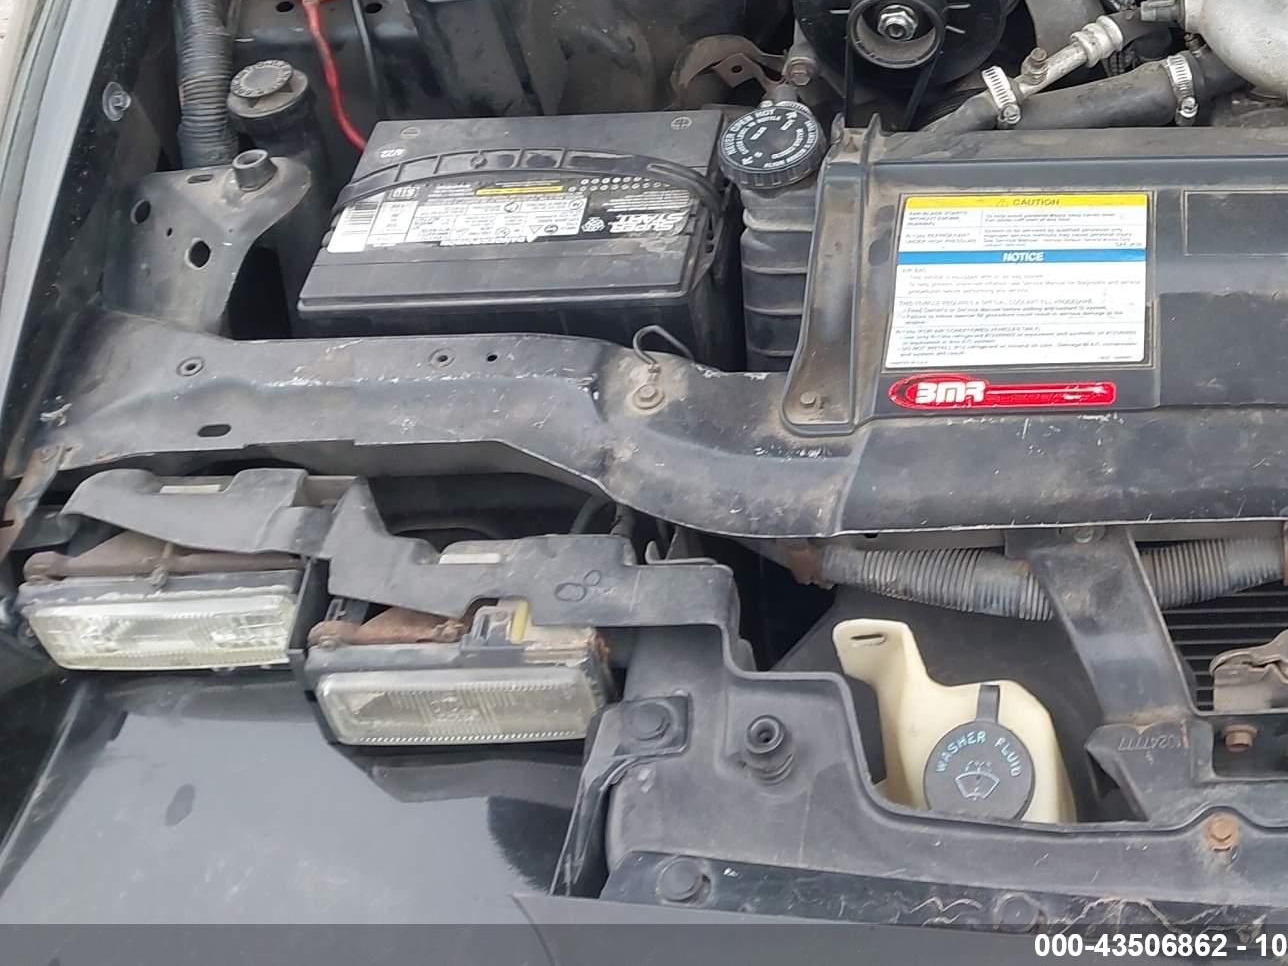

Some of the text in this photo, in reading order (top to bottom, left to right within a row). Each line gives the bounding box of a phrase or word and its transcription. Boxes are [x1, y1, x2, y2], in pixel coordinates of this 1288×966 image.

[1012, 198, 1061, 207] CAUTION
[607, 220, 674, 234] SUPER
[1002, 251, 1045, 263] NOTICE
[915, 381, 986, 404] BMR
[935, 730, 1022, 777] WASHER FLUID
